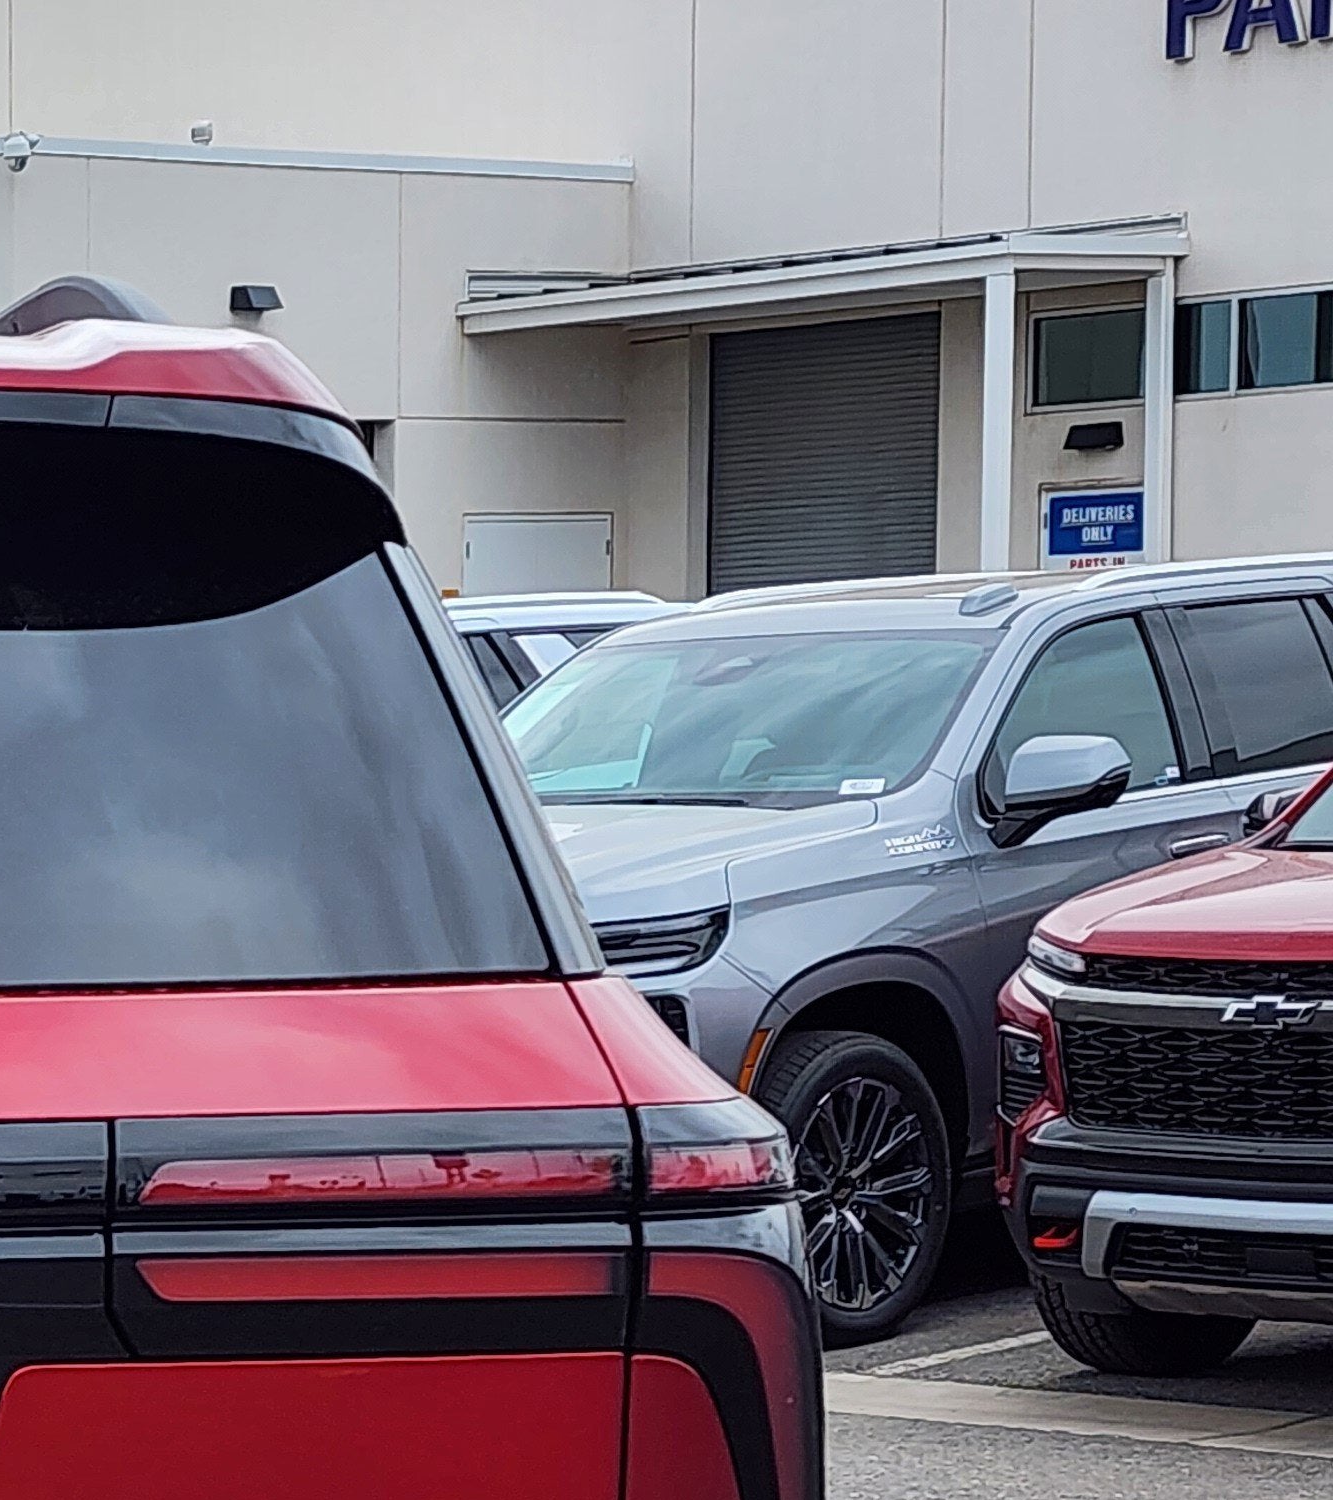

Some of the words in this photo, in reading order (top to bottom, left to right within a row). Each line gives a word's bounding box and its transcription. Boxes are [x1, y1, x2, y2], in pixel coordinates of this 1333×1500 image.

[1166, 0, 1333, 59] PA
[1062, 505, 1135, 524] DELIVERIES
[1082, 526, 1114, 542] ONLY
